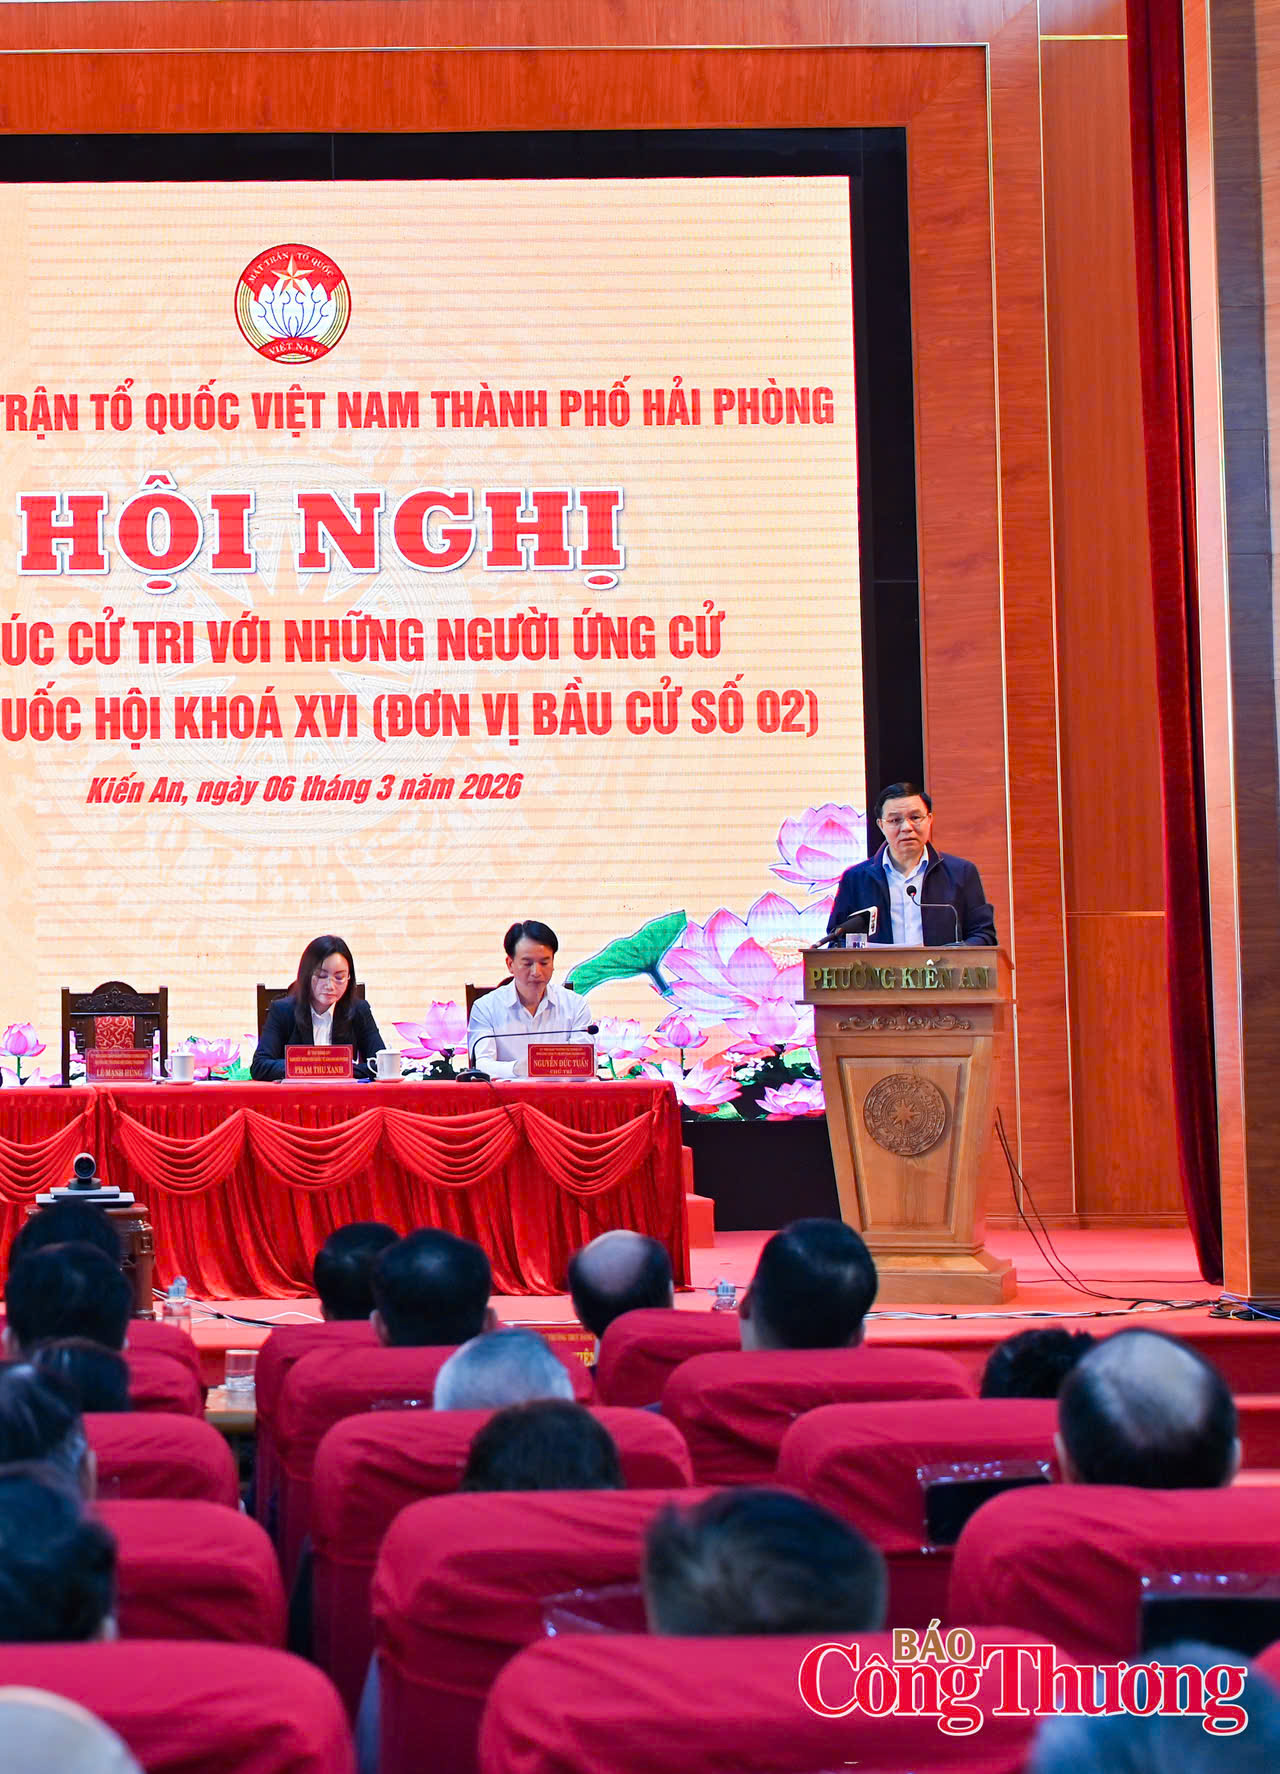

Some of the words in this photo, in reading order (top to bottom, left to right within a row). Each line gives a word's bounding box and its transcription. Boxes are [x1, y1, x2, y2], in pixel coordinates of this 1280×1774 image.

[90, 378, 134, 431] TỔ
[146, 379, 239, 434] QUỐC
[252, 384, 325, 437] VIỆT
[338, 391, 419, 428] NAM
[431, 383, 547, 427] THÀNH
[560, 376, 631, 427] PHỐ
[643, 376, 700, 425] HẢI
[714, 378, 833, 425] PHÒNG
[18, 472, 254, 592] HỘI
[295, 488, 623, 588] NGHỊ
[69, 606, 125, 665] CỬ
[133, 621, 194, 664] TRI
[207, 611, 270, 663] VỚI
[284, 610, 424, 662] NHỮNG
[437, 607, 559, 661] NGƯỜI
[573, 608, 656, 660] ỨNG
[669, 600, 725, 659] CỬ
[96, 688, 160, 750] HỘI
[175, 686, 282, 739] KHOÁ
[295, 695, 357, 737] XVI
[373, 689, 469, 742] (ĐƠN
[482, 693, 518, 746] VỊ
[533, 677, 612, 735] BẦU
[626, 676, 682, 734] CỬ
[692, 674, 744, 734] SỐ
[757, 690, 818, 737] 02)
[86, 772, 144, 803] Kiến
[148, 777, 187, 805] An,
[196, 776, 259, 805] ngày
[263, 776, 296, 802] 06
[301, 774, 372, 804] tháng
[377, 775, 395, 800] 3
[399, 773, 455, 800] năm
[459, 773, 524, 799] 2026
[809, 959, 895, 989] PHƯỜNG
[901, 956, 952, 989] KIẾN
[959, 966, 988, 989] AN
